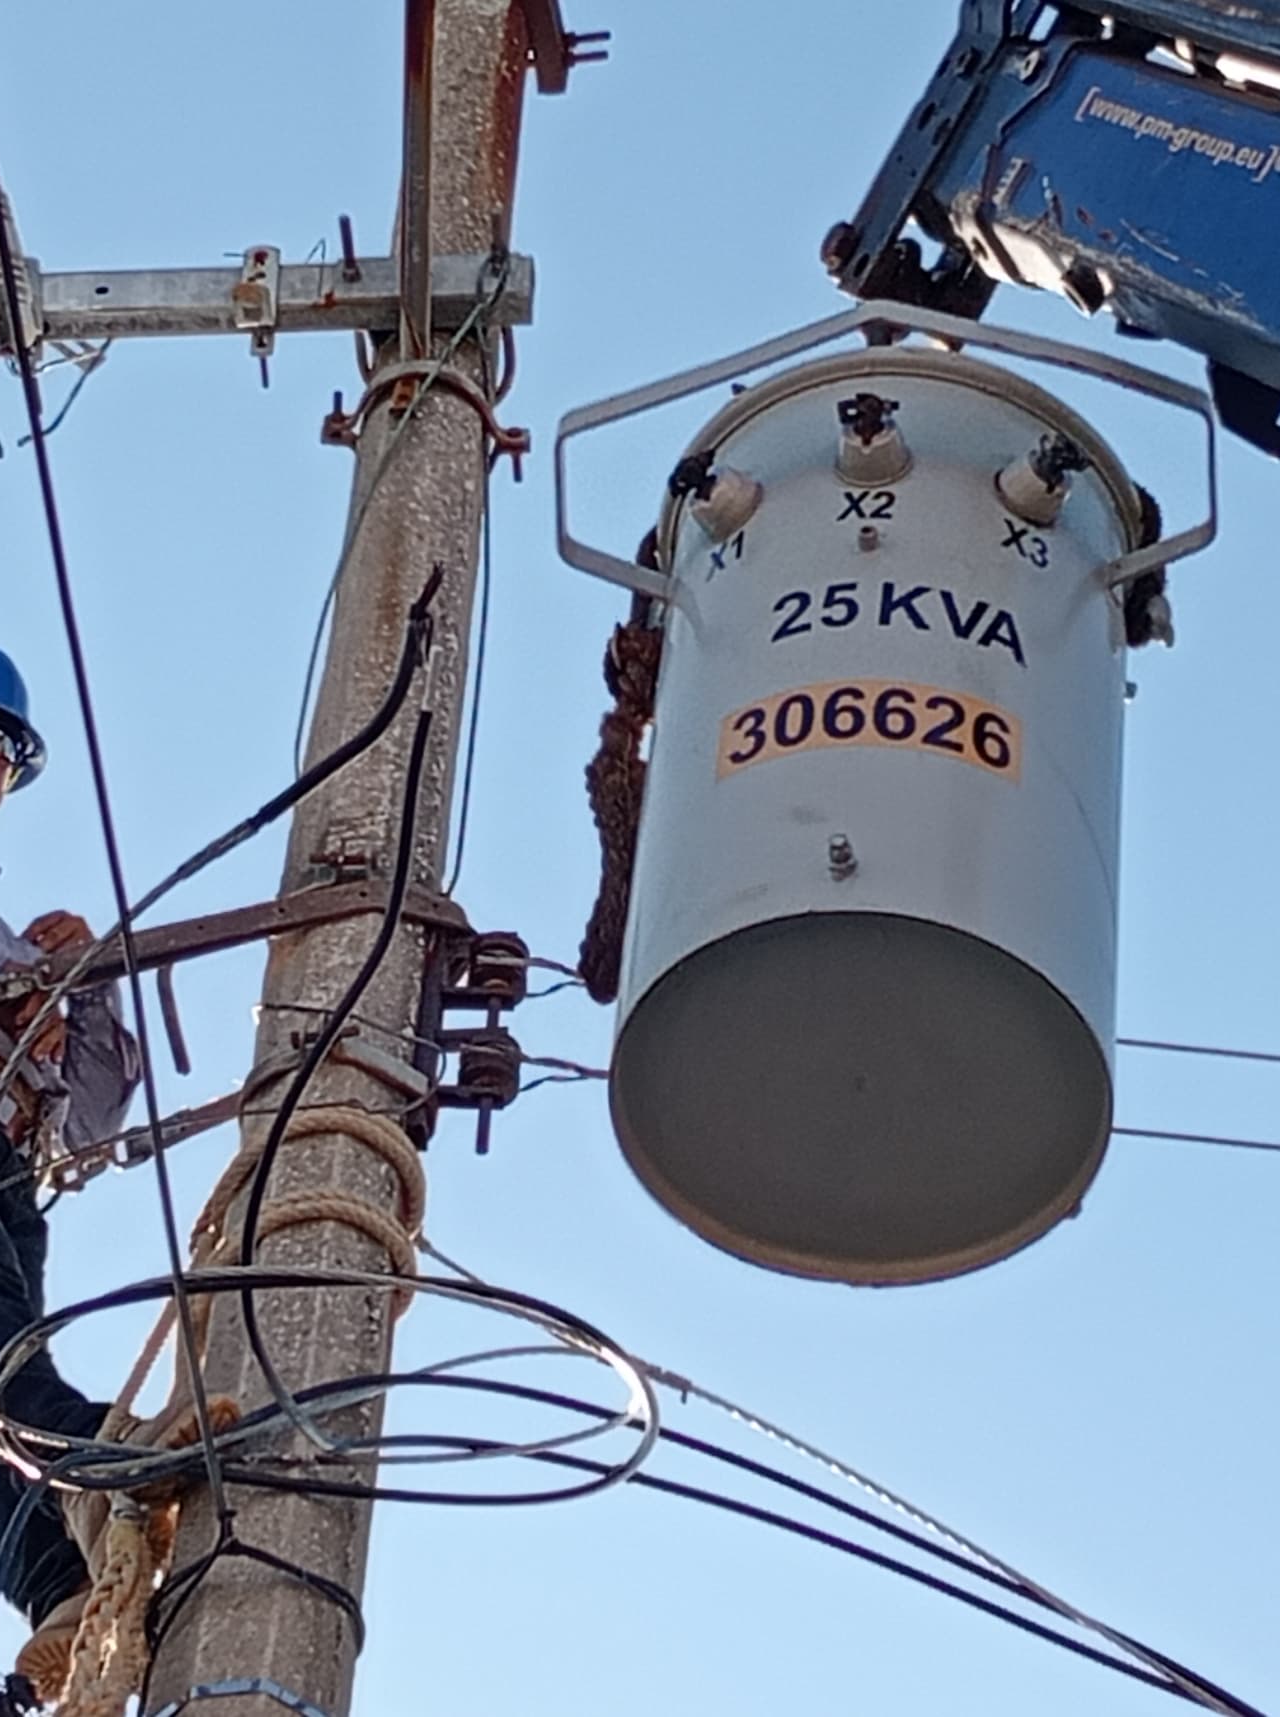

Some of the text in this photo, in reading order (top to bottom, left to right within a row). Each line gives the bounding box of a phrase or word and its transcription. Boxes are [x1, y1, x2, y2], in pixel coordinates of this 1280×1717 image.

[836, 490, 896, 521] X2
[705, 530, 745, 582] X1
[1001, 518, 1049, 568] X3
[771, 581, 1027, 668] 25 KVA
[728, 687, 1011, 769] 306626
